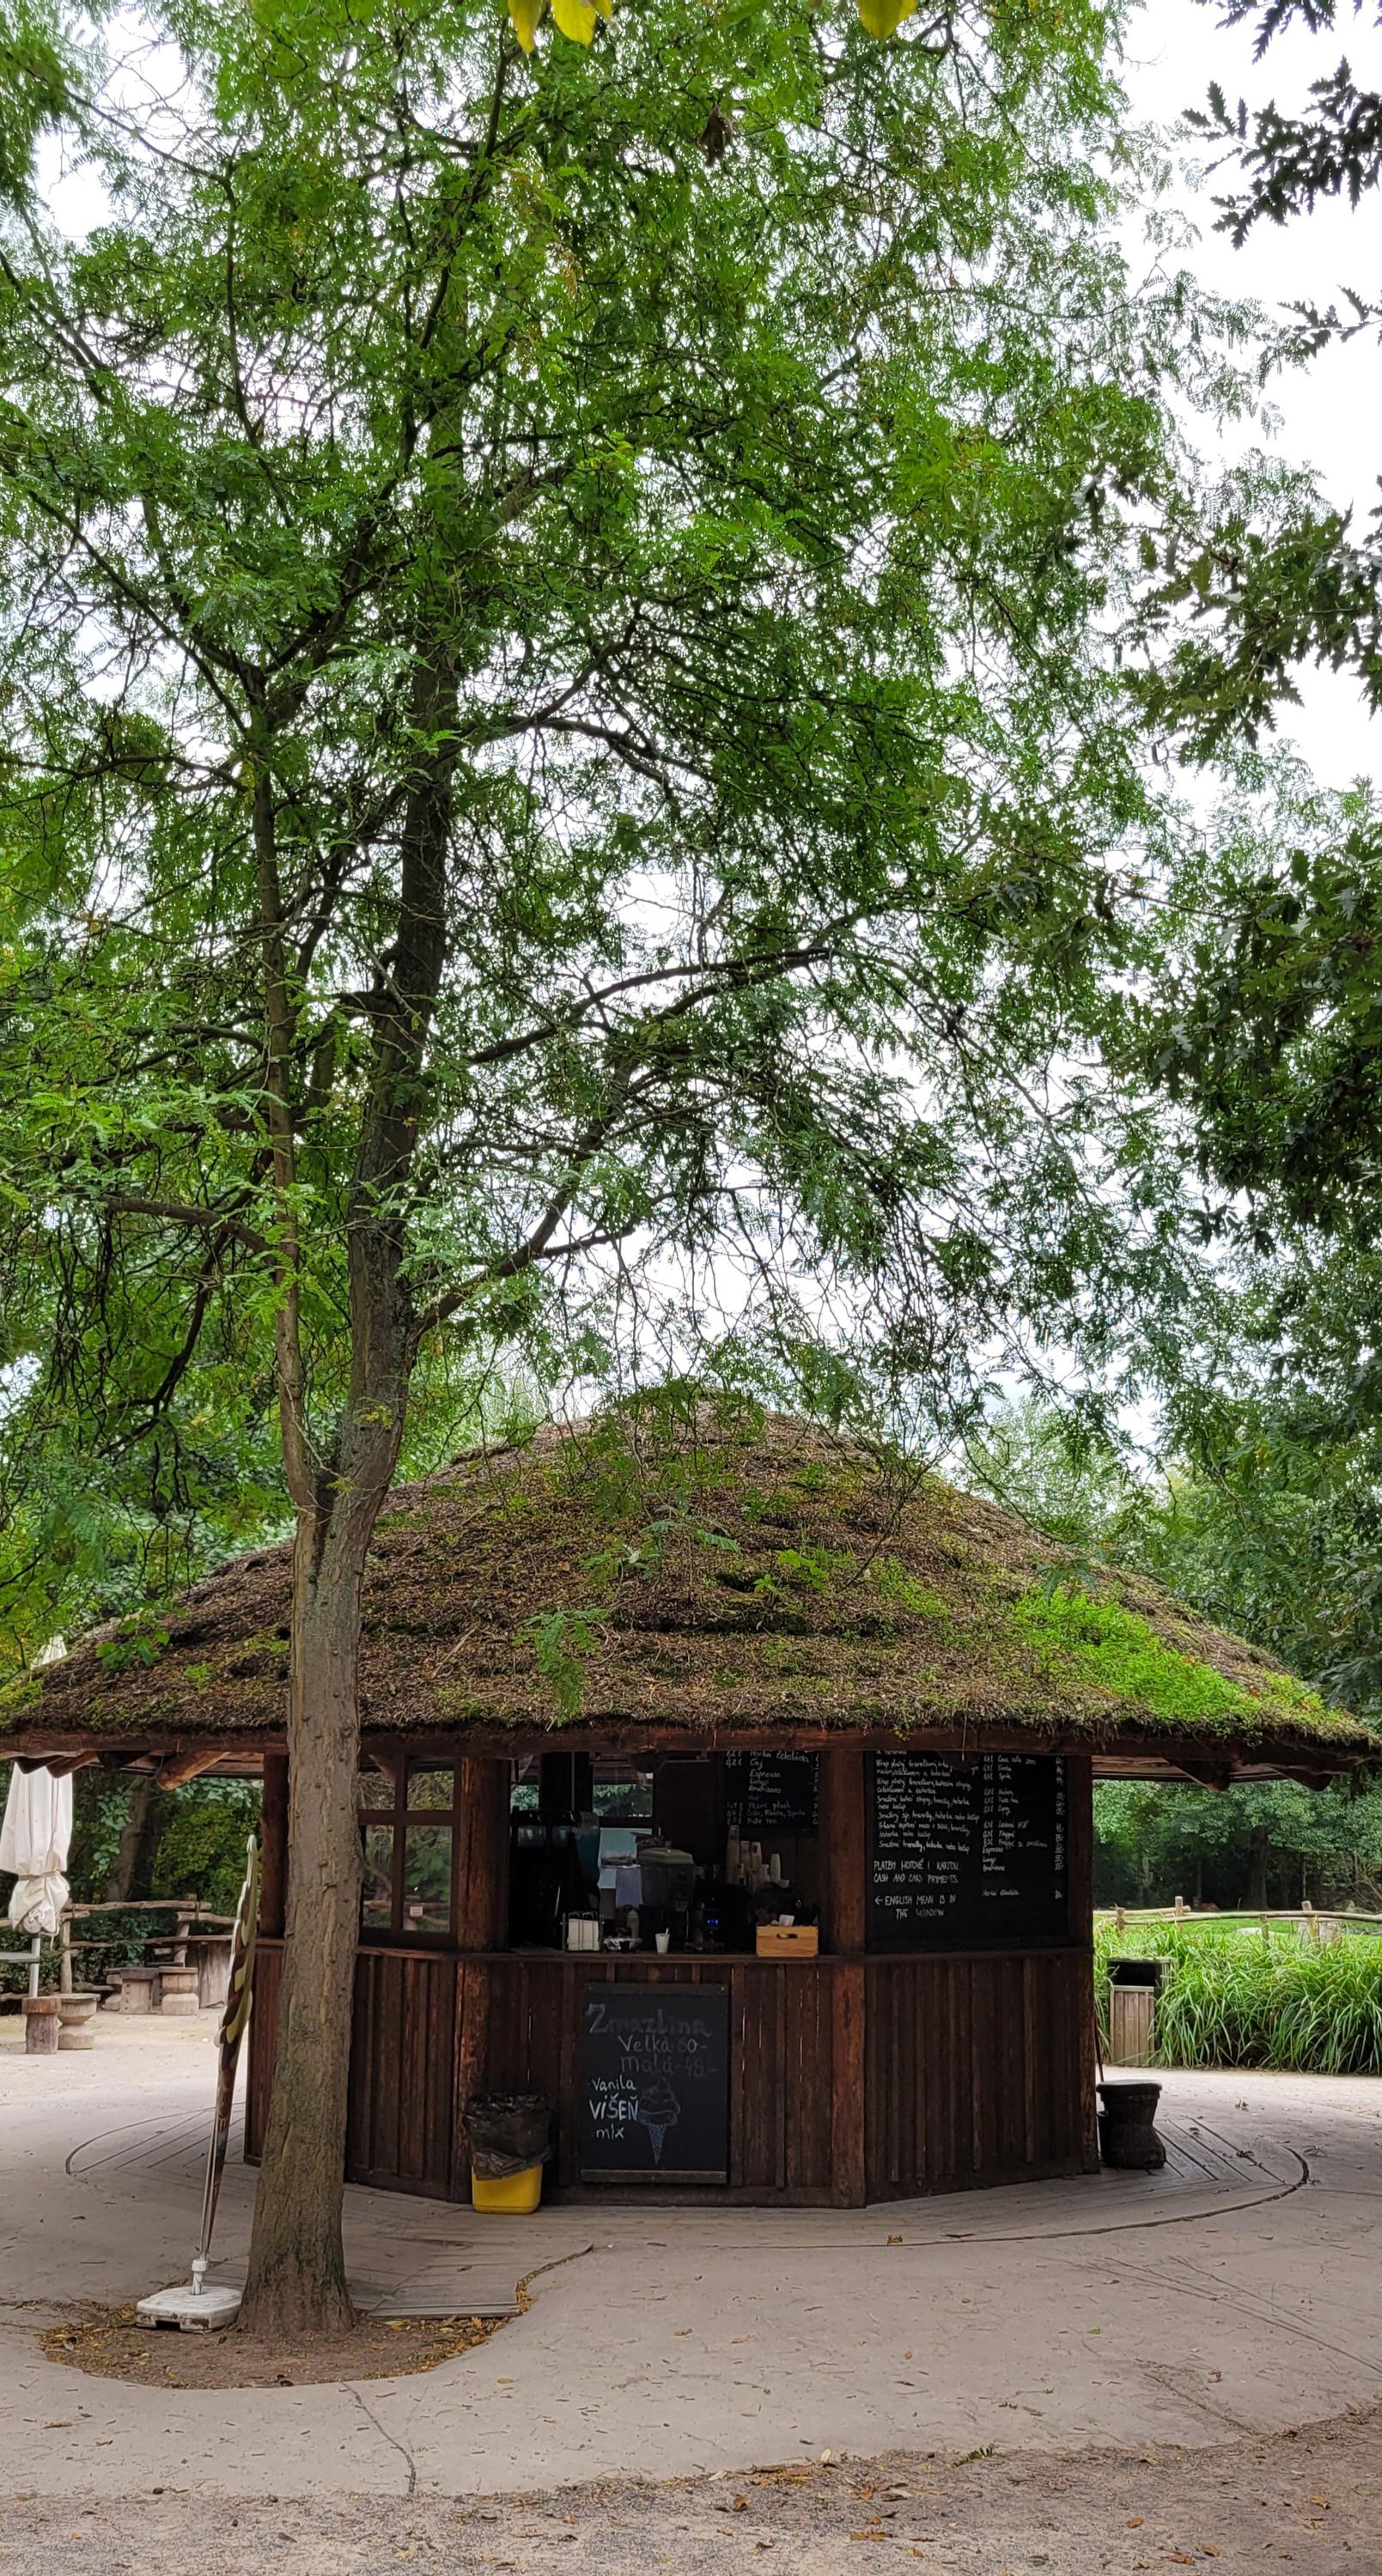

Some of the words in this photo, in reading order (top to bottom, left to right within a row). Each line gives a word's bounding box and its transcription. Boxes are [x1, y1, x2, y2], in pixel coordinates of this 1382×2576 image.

[749, 1769, 782, 1780] Espresso
[874, 1860, 897, 1872] PLATBY
[936, 1861, 959, 1871] KARTOU
[873, 1874, 889, 1883] CASH
[892, 1874, 906, 1883] AND
[908, 1874, 923, 1883] CARD
[927, 1874, 959, 1885] PAYMENTS
[885, 1895, 913, 1906] ENGLISH
[916, 1895, 935, 1905] MENU
[939, 1894, 946, 1905] IS
[949, 1894, 957, 1904] IN
[895, 1908, 909, 1920] THE
[915, 1908, 945, 1917] WINDOW
[595, 2123, 625, 2139] mix
